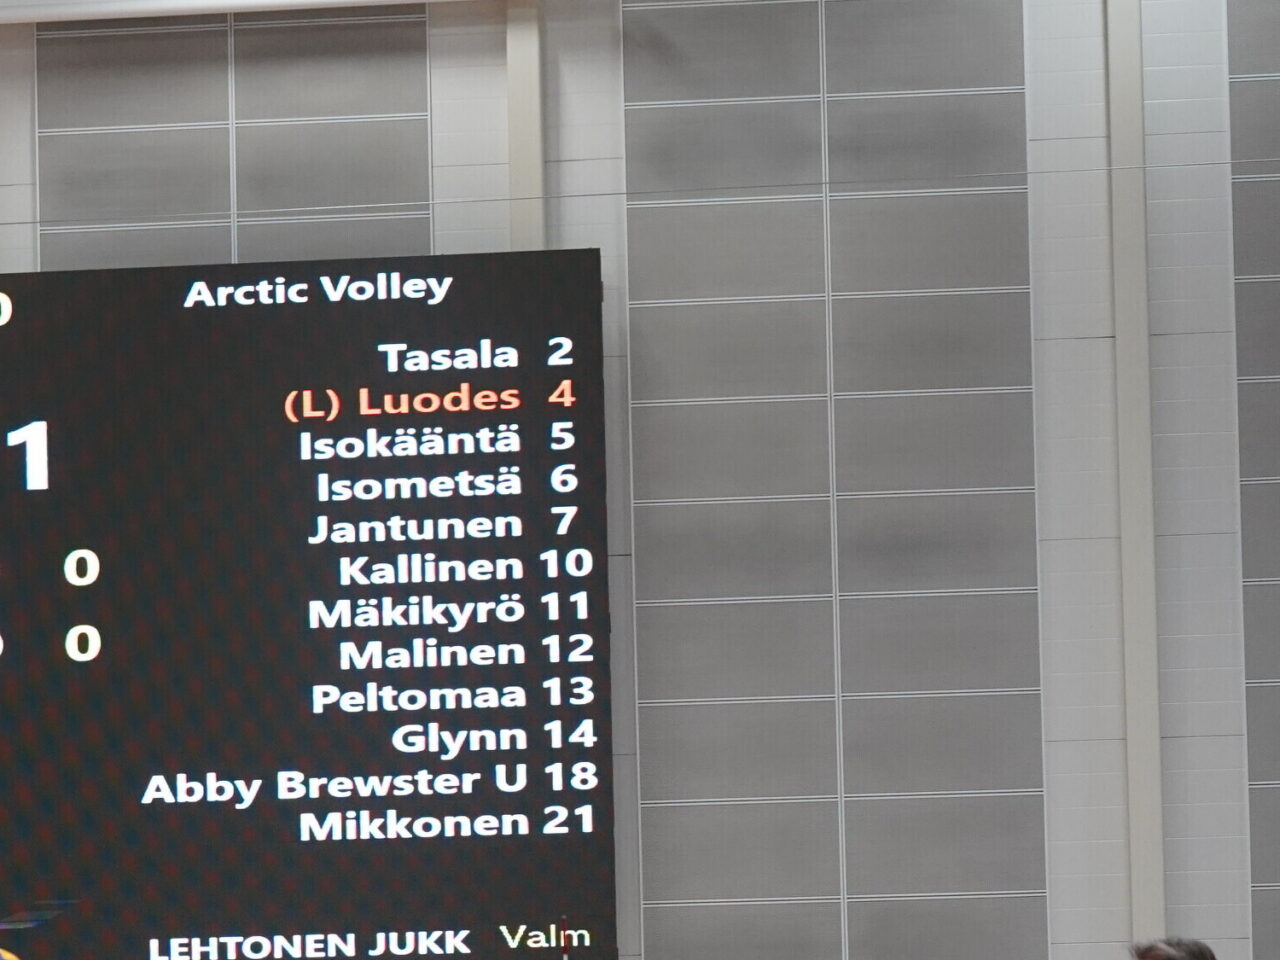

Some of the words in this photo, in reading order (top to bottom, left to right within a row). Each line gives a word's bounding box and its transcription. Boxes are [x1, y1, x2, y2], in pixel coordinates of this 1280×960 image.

[184, 277, 308, 307] Arctic
[320, 272, 453, 305] Volley
[378, 339, 518, 372] Tasala
[548, 337, 573, 365] 2
[285, 389, 340, 422] (L)
[360, 383, 521, 415] Luodes
[548, 380, 576, 407] 4
[7, 421, 48, 490] 1
[301, 424, 520, 460] Isokääntä
[551, 422, 575, 450] 5
[318, 466, 521, 501] Isometsä
[551, 464, 578, 492] 6
[308, 516, 522, 544] Jantunen
[551, 506, 578, 535] 7
[64, 549, 100, 586] 0
[340, 553, 523, 585] Kallinen
[540, 549, 593, 577] 10
[309, 594, 524, 632] Mäkikyrö
[541, 591, 588, 620] 11
[65, 625, 101, 661] 0
[340, 638, 525, 670] Malinen
[542, 634, 593, 662] 12
[313, 682, 526, 713] Peltomaa
[543, 676, 594, 705] 13
[392, 723, 527, 760] Glynn
[544, 719, 597, 748] 14
[141, 772, 262, 809] Abby
[277, 769, 481, 799] Brewster
[495, 764, 527, 792] U
[545, 762, 598, 791] 18
[300, 809, 529, 841] Mikkonen
[543, 805, 593, 834] 21
[368, 930, 471, 956] JUKK
[499, 924, 590, 948] Valm
